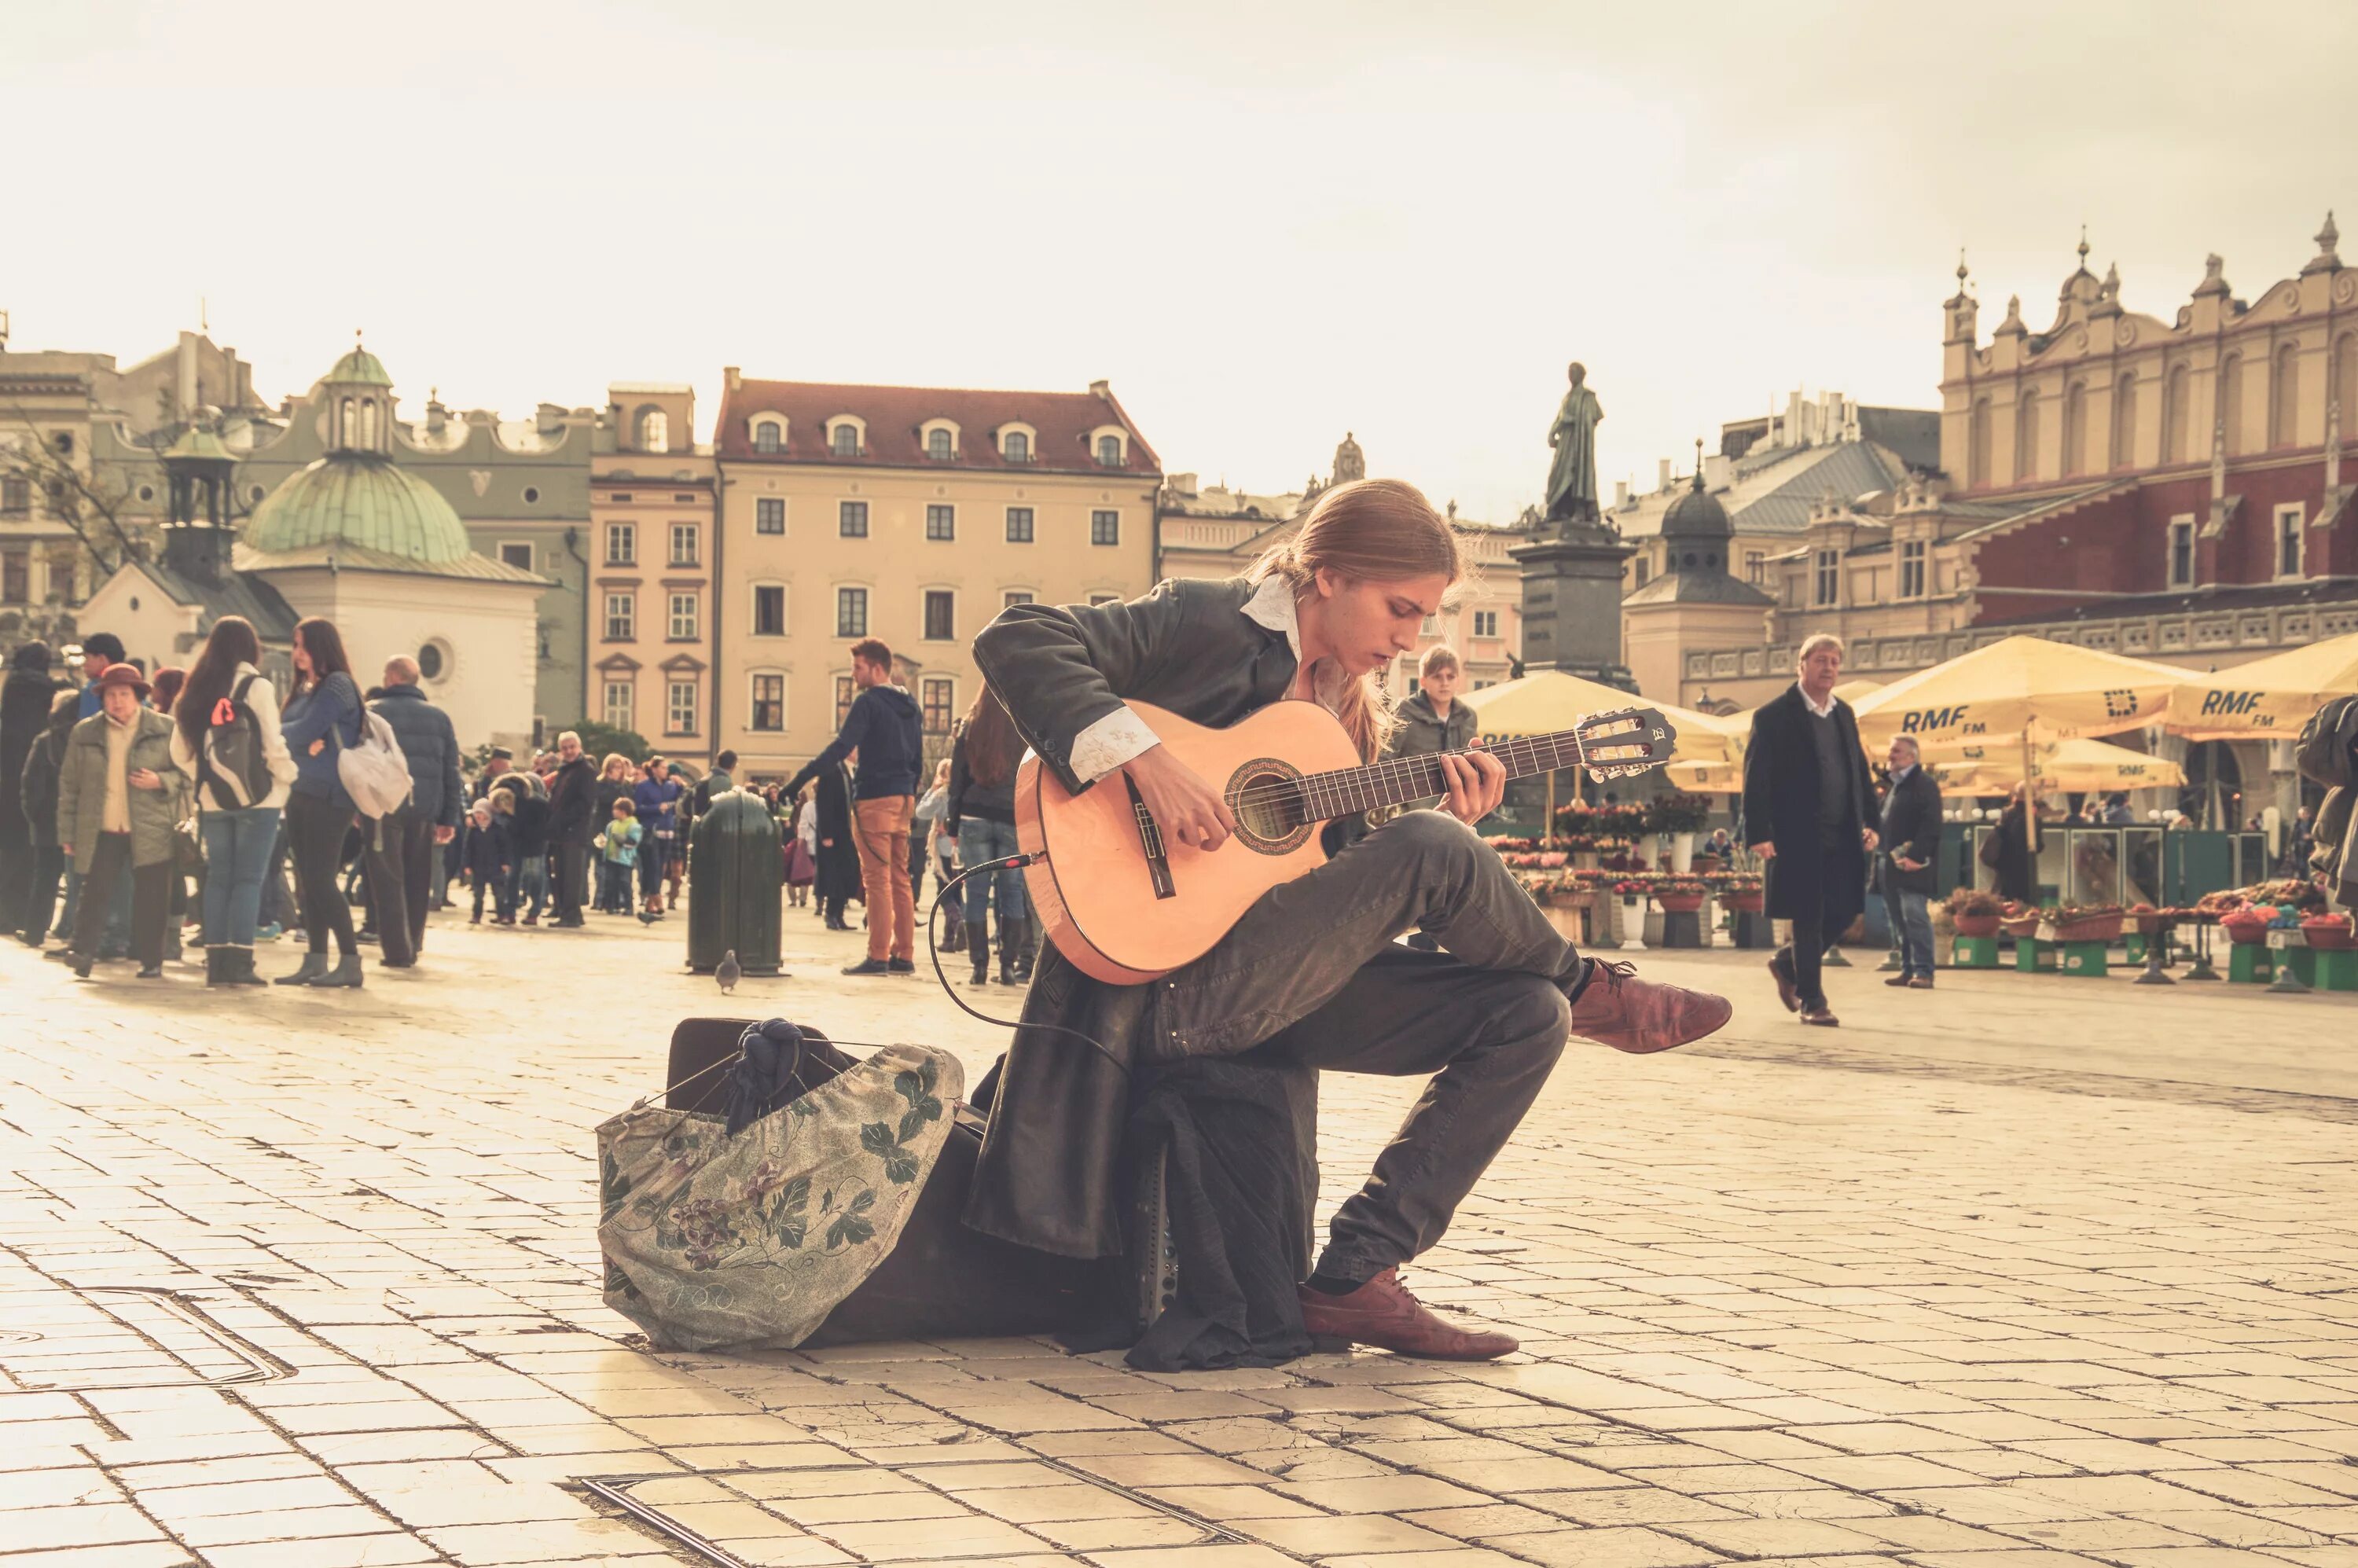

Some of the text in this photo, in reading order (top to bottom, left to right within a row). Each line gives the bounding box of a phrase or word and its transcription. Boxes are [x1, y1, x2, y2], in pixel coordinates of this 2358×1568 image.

[1902, 705, 1985, 734] RMF FM
[2202, 690, 2275, 727] RMF FM
